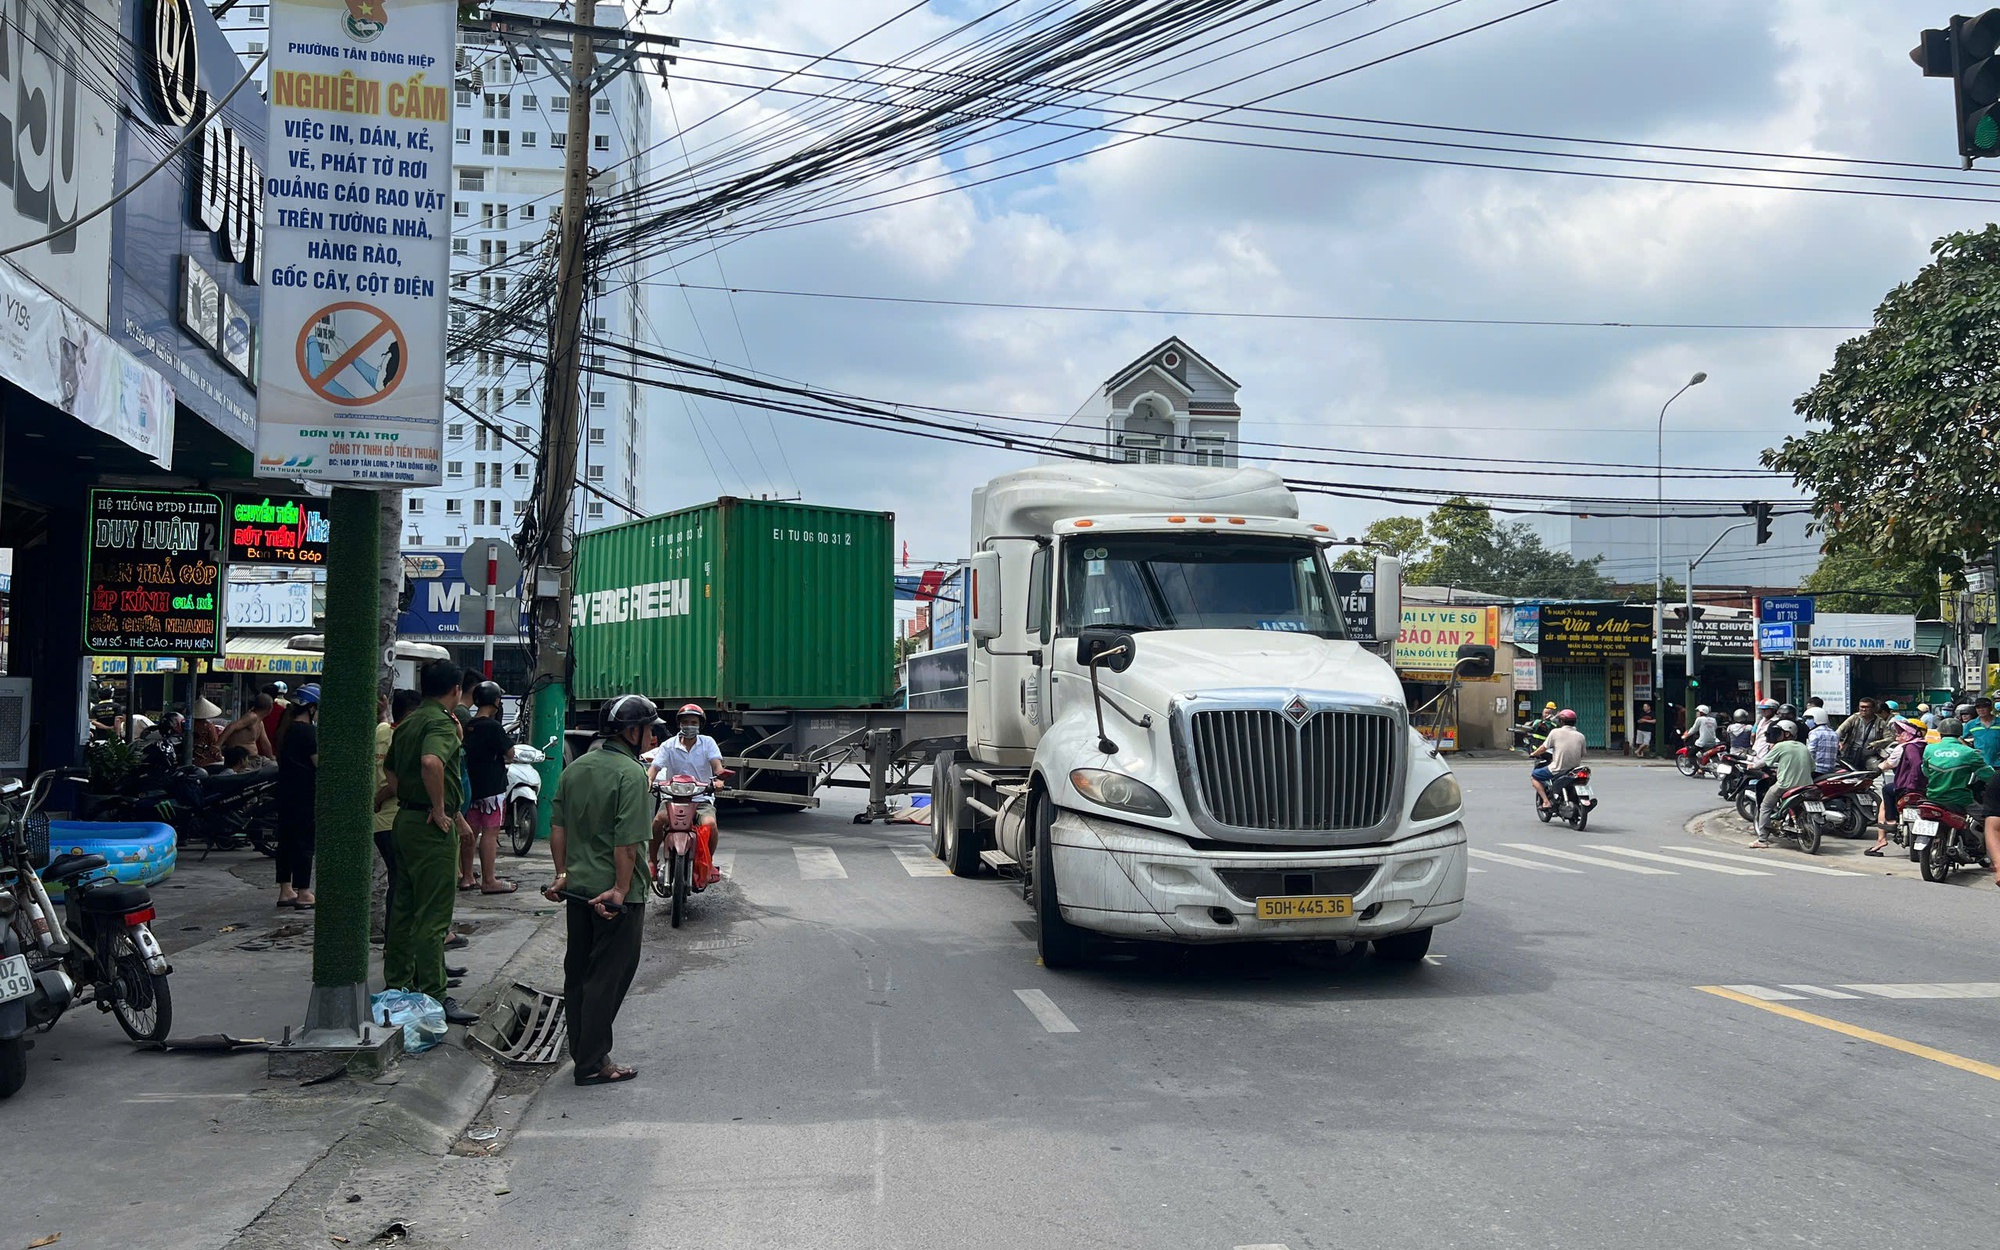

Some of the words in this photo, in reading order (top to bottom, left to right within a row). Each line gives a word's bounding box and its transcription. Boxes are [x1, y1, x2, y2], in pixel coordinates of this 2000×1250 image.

[288, 42, 339, 58] PHƯỜNG
[343, 47, 367, 60] TÂN
[371, 50, 404, 64] ĐÔNG
[408, 54, 435, 68] HIỆP
[274, 70, 381, 116] NGHIÊM
[387, 72, 448, 123] CẤM
[284, 118, 323, 142] VIỆC
[330, 124, 353, 145] IN,
[360, 126, 401, 149] DÁN,
[407, 128, 434, 152] KẺ,
[289, 148, 315, 171] VẼ,
[322, 152, 367, 174] PHÁT
[373, 155, 394, 176] TỜ
[399, 160, 428, 179] RƠI
[268, 175, 328, 200] QUẢNG
[334, 182, 370, 203] CÁO
[376, 188, 409, 207] RAO
[415, 189, 446, 213] VẶT
[278, 208, 323, 229] TRÊN
[329, 213, 387, 234] TƯỜNG
[393, 217, 433, 240] NHÀ,
[308, 239, 357, 262] HÀNG
[363, 243, 401, 267] RÀO,
[272, 264, 308, 288] GỐC
[314, 270, 350, 293] CÂY,
[356, 273, 389, 296] CỘT
[394, 276, 434, 300] ĐIỆN
[300, 430, 328, 438] ĐƠN
[333, 431, 345, 440] VỊ
[350, 430, 372, 439] TÀI
[374, 432, 400, 441] TRỢ
[329, 442, 350, 455] CÔNG
[352, 444, 361, 455] TY
[363, 444, 383, 456] TNHH
[415, 446, 438, 462] THUẬN
[98, 497, 113, 512] HỆ
[116, 496, 153, 512] THỐNG
[96, 519, 139, 548] DUY
[142, 516, 199, 556] LUẬN
[204, 523, 215, 551] 2
[299, 550, 322, 563] Góp
[137, 557, 175, 583] TRẢ
[180, 560, 217, 585] GÓP
[92, 585, 118, 611] ÉP
[121, 586, 170, 612] KÍNH
[172, 594, 194, 610] GIÁ
[197, 593, 213, 610] RẺ
[572, 578, 689, 627] EVERGREEN
[165, 619, 214, 633] NHANH
[1421, 611, 1436, 622] LÝ
[1440, 612, 1456, 623] VÉ
[1461, 612, 1477, 623] SỐ
[1562, 617, 1591, 632] Vân
[1596, 617, 1631, 632] Anh
[1787, 612, 1798, 620] 743
[92, 638, 107, 646] SIM
[109, 636, 122, 646] SỐ
[175, 639, 192, 649] PHỤ
[194, 638, 214, 650] KIỆN
[1397, 625, 1432, 644] BẢO
[1437, 630, 1459, 645] AN
[1465, 632, 1475, 645] 2
[1812, 635, 1834, 647] CẮT
[1836, 636, 1856, 647] TÓC
[1860, 639, 1885, 648] NAM
[1894, 638, 1911, 649] NỮ
[102, 660, 126, 672] CƠM
[224, 657, 244, 670] QUÁN
[257, 660, 261, 670] 7
[269, 659, 291, 672] CƠM
[295, 658, 308, 672] GÀ
[1265, 900, 1344, 914] 50H-445.36
